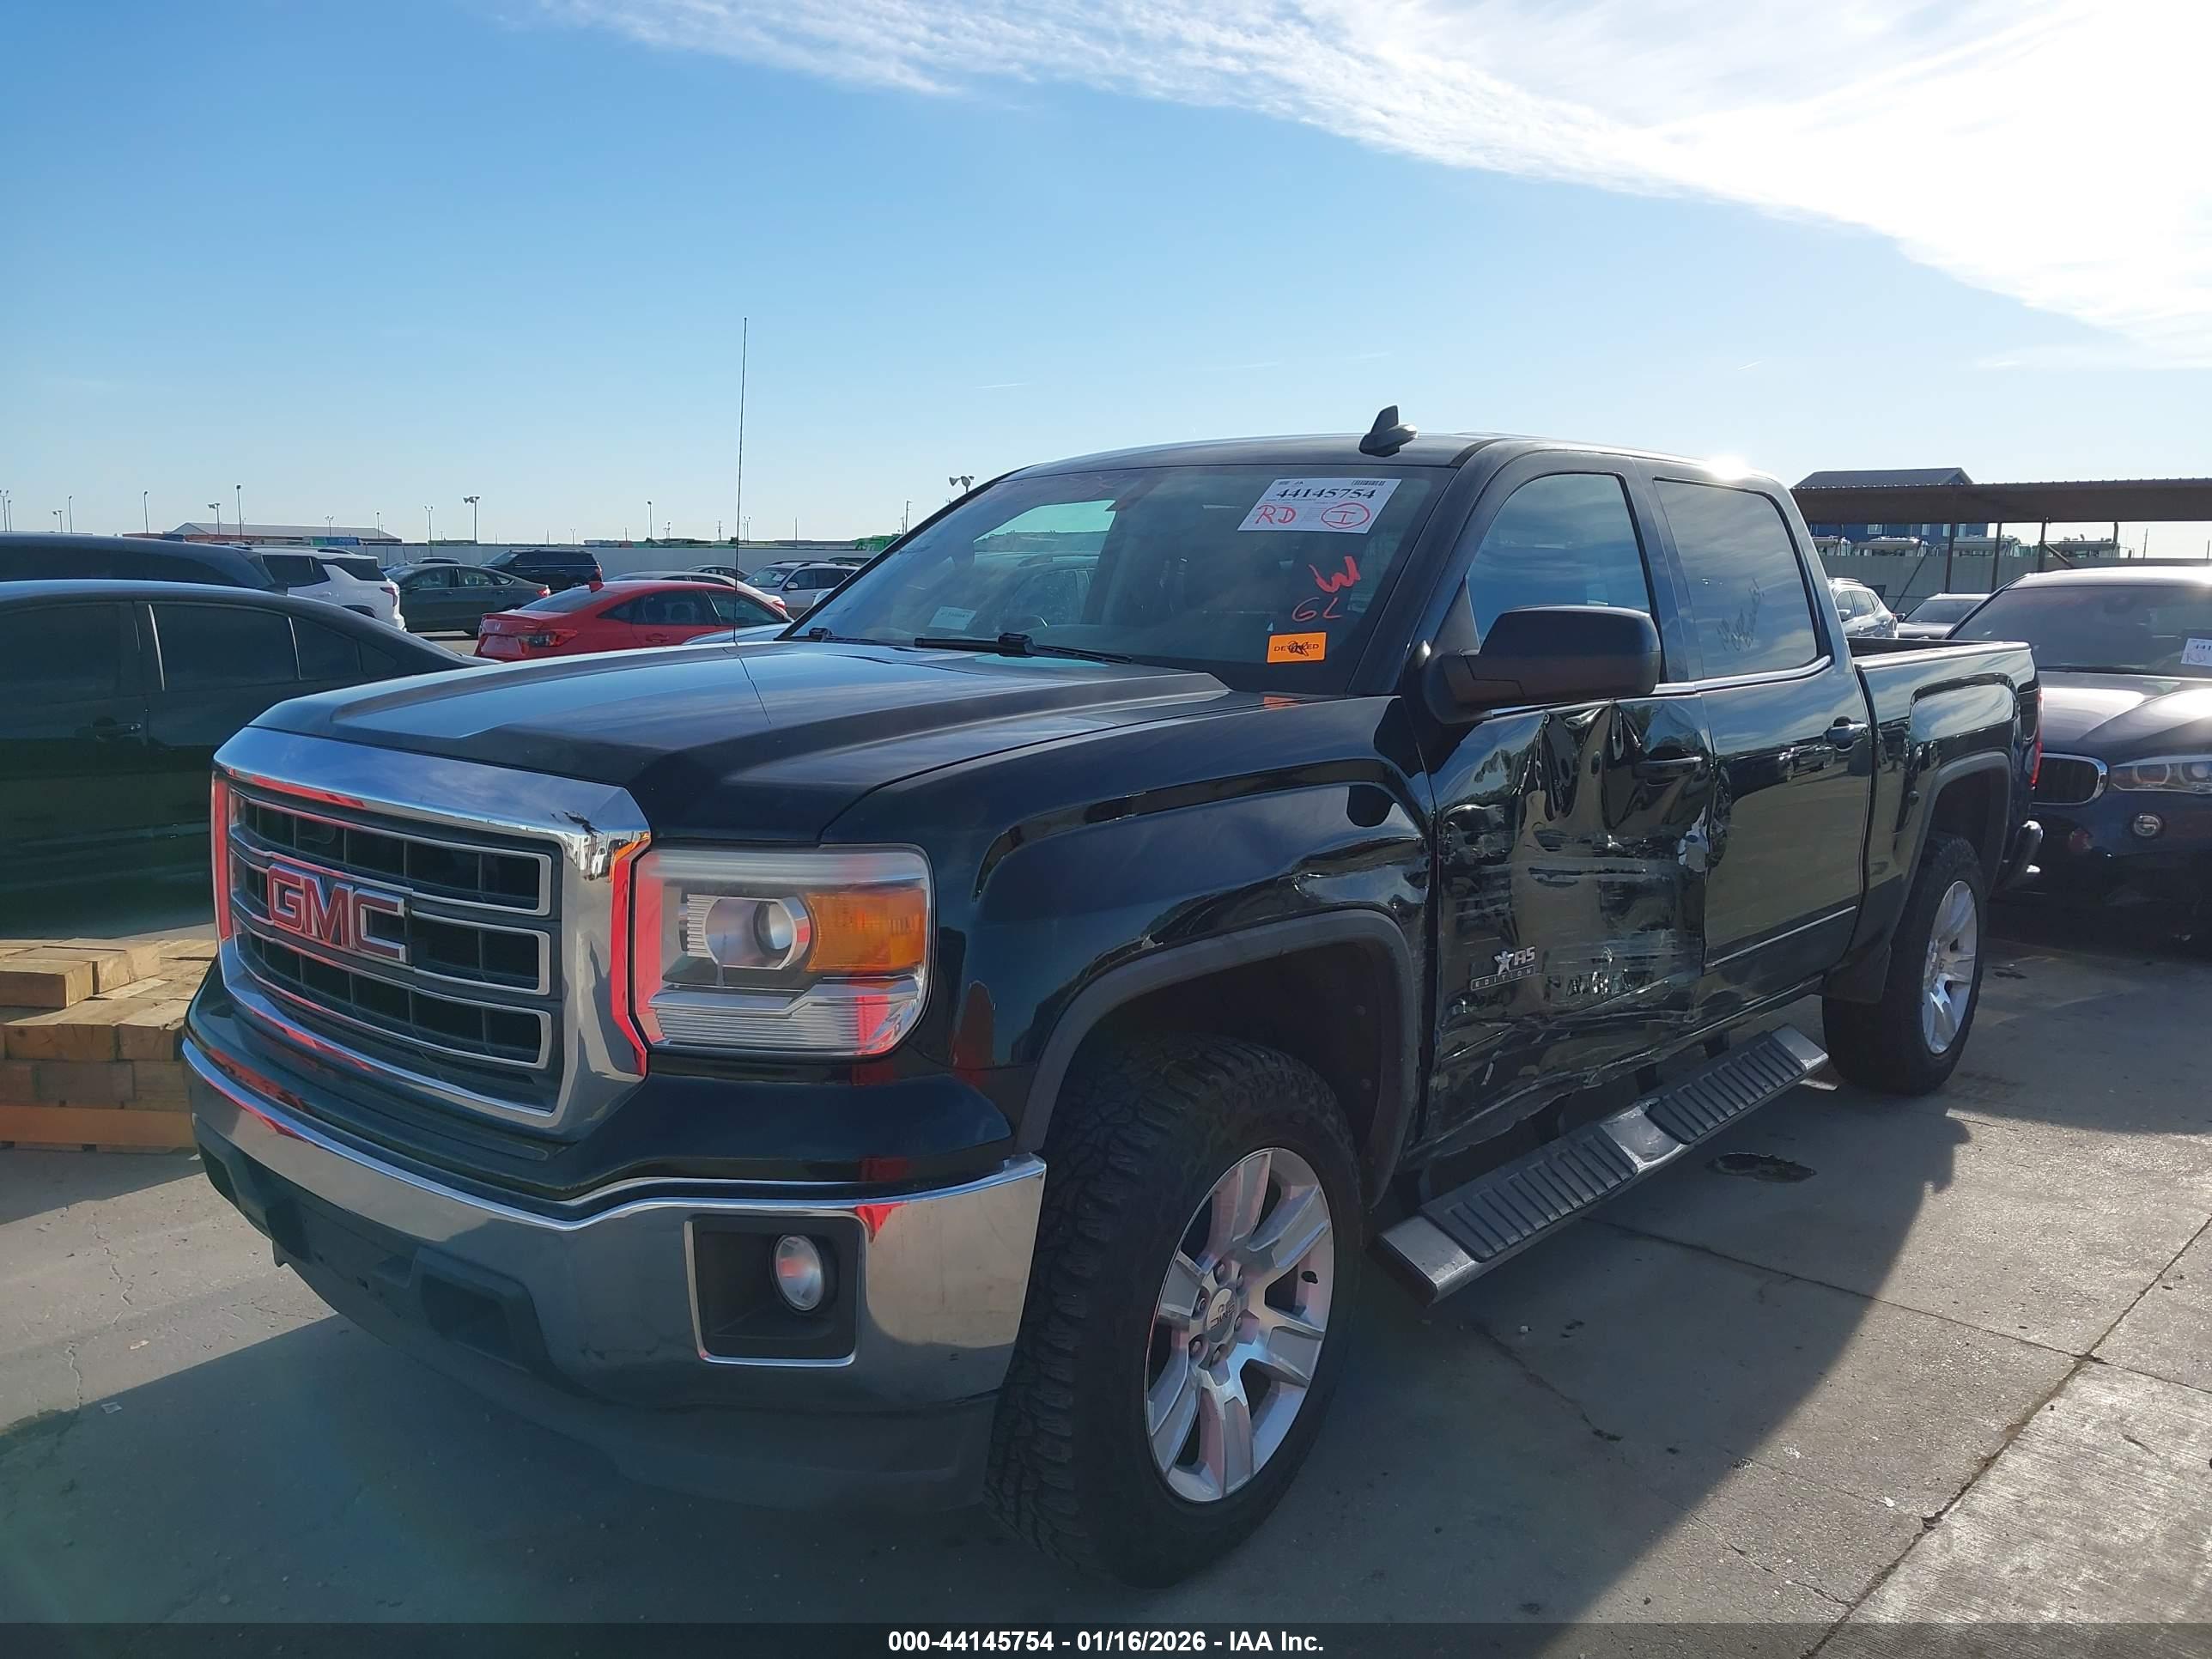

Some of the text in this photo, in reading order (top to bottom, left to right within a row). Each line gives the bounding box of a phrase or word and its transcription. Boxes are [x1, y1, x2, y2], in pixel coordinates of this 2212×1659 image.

[1276, 489, 1376, 499] 44145754
[1255, 504, 1297, 525] RD
[1308, 556, 1360, 592] W
[267, 863, 406, 963] GMC
[1474, 968, 1532, 988] EDITION
